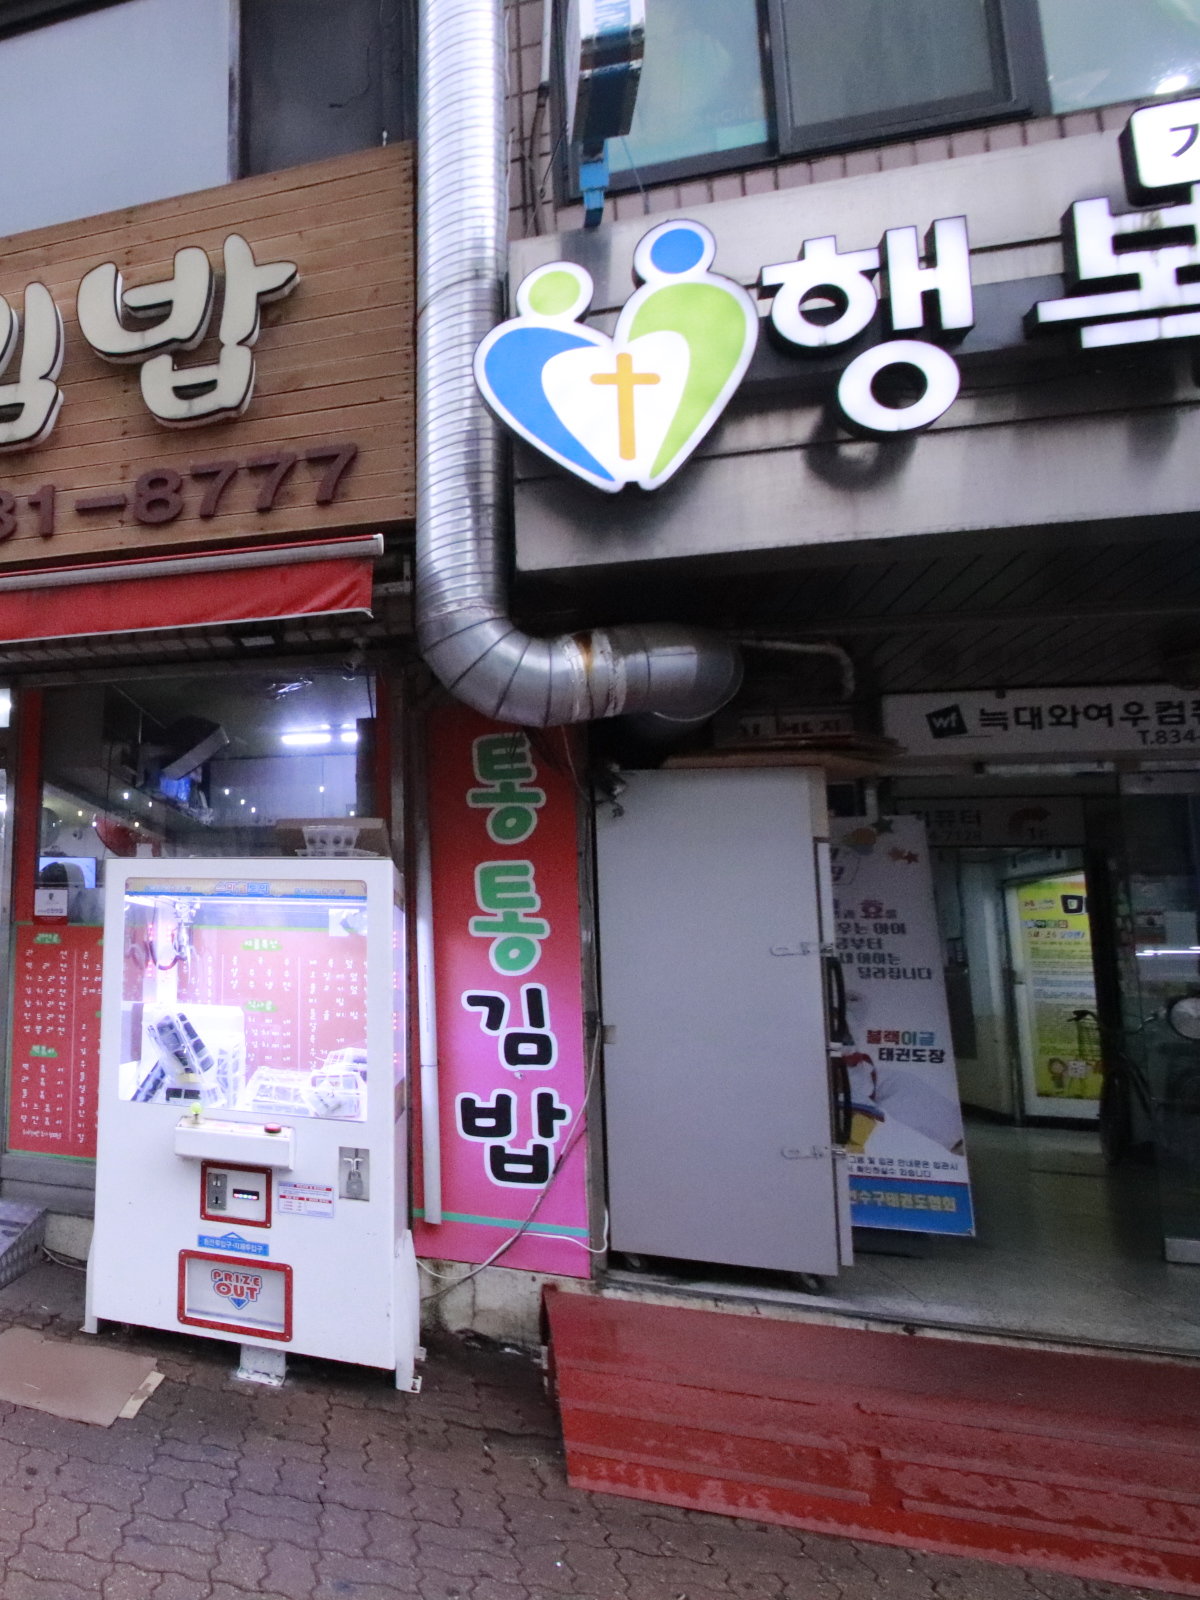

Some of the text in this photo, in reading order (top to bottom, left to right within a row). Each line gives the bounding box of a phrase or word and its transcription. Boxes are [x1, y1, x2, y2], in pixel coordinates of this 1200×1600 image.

[455, 732, 574, 1189] 통통김밥
[866, 1030, 935, 1046] 블랙이글
[878, 1047, 945, 1063] 태권도장
[212, 1270, 261, 1287] PRIZE
[215, 1281, 260, 1301] OUT
